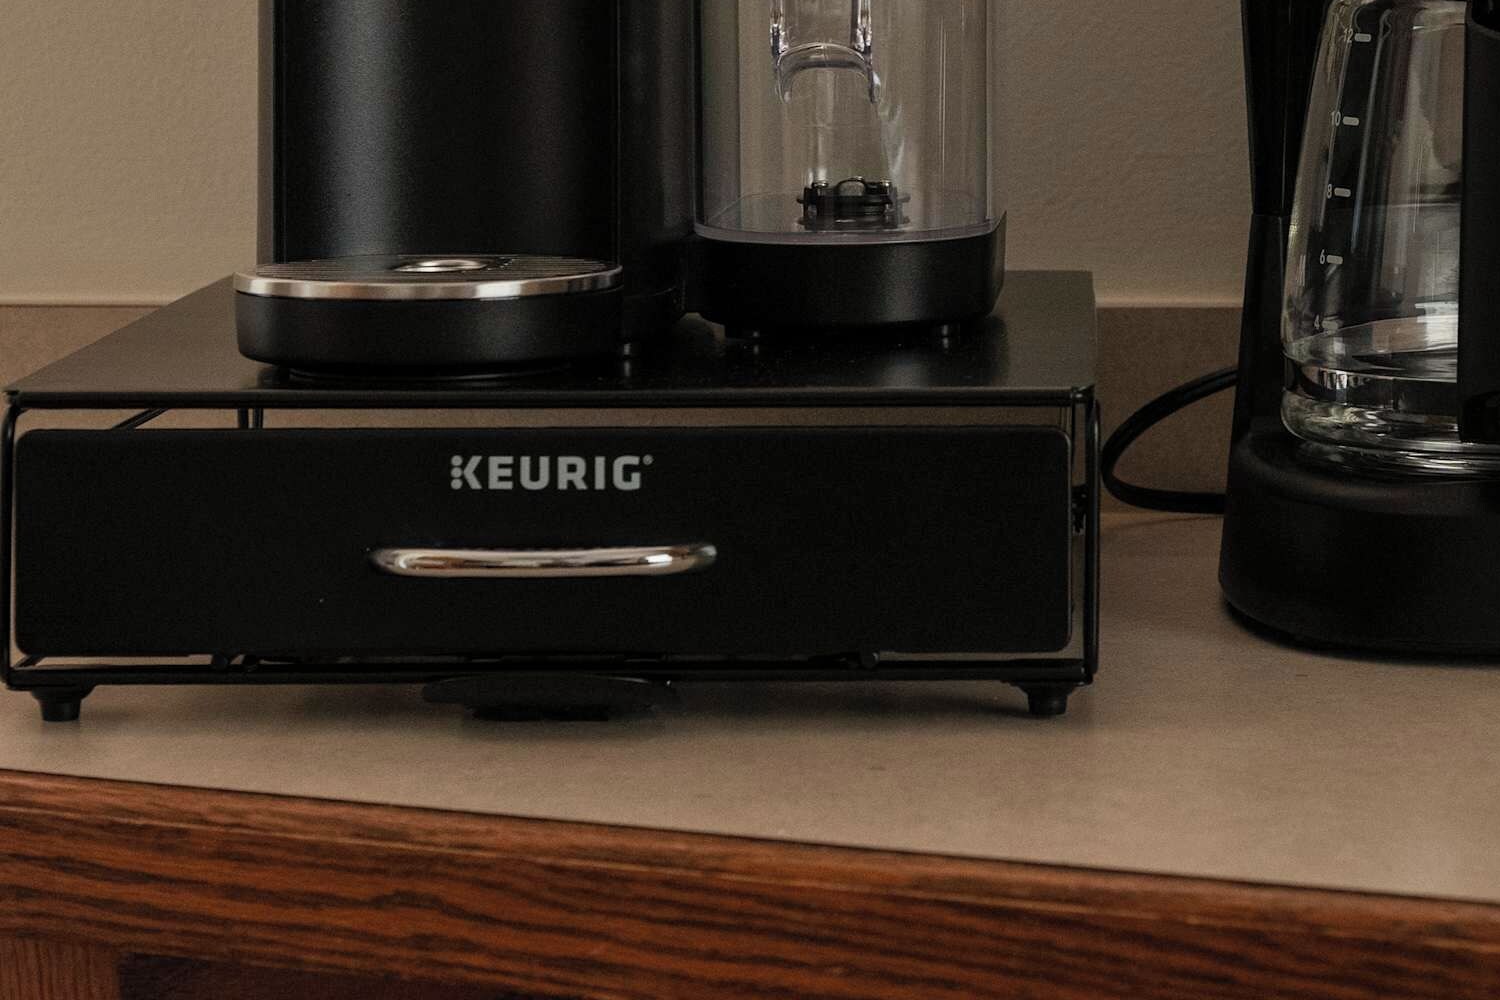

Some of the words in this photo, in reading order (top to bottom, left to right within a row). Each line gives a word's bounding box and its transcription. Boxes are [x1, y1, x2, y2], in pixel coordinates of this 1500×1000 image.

[1331, 111, 1341, 127] 10
[1326, 183, 1333, 199] 8
[1320, 249, 1326, 265] 6
[451, 455, 642, 491] KEURIG
